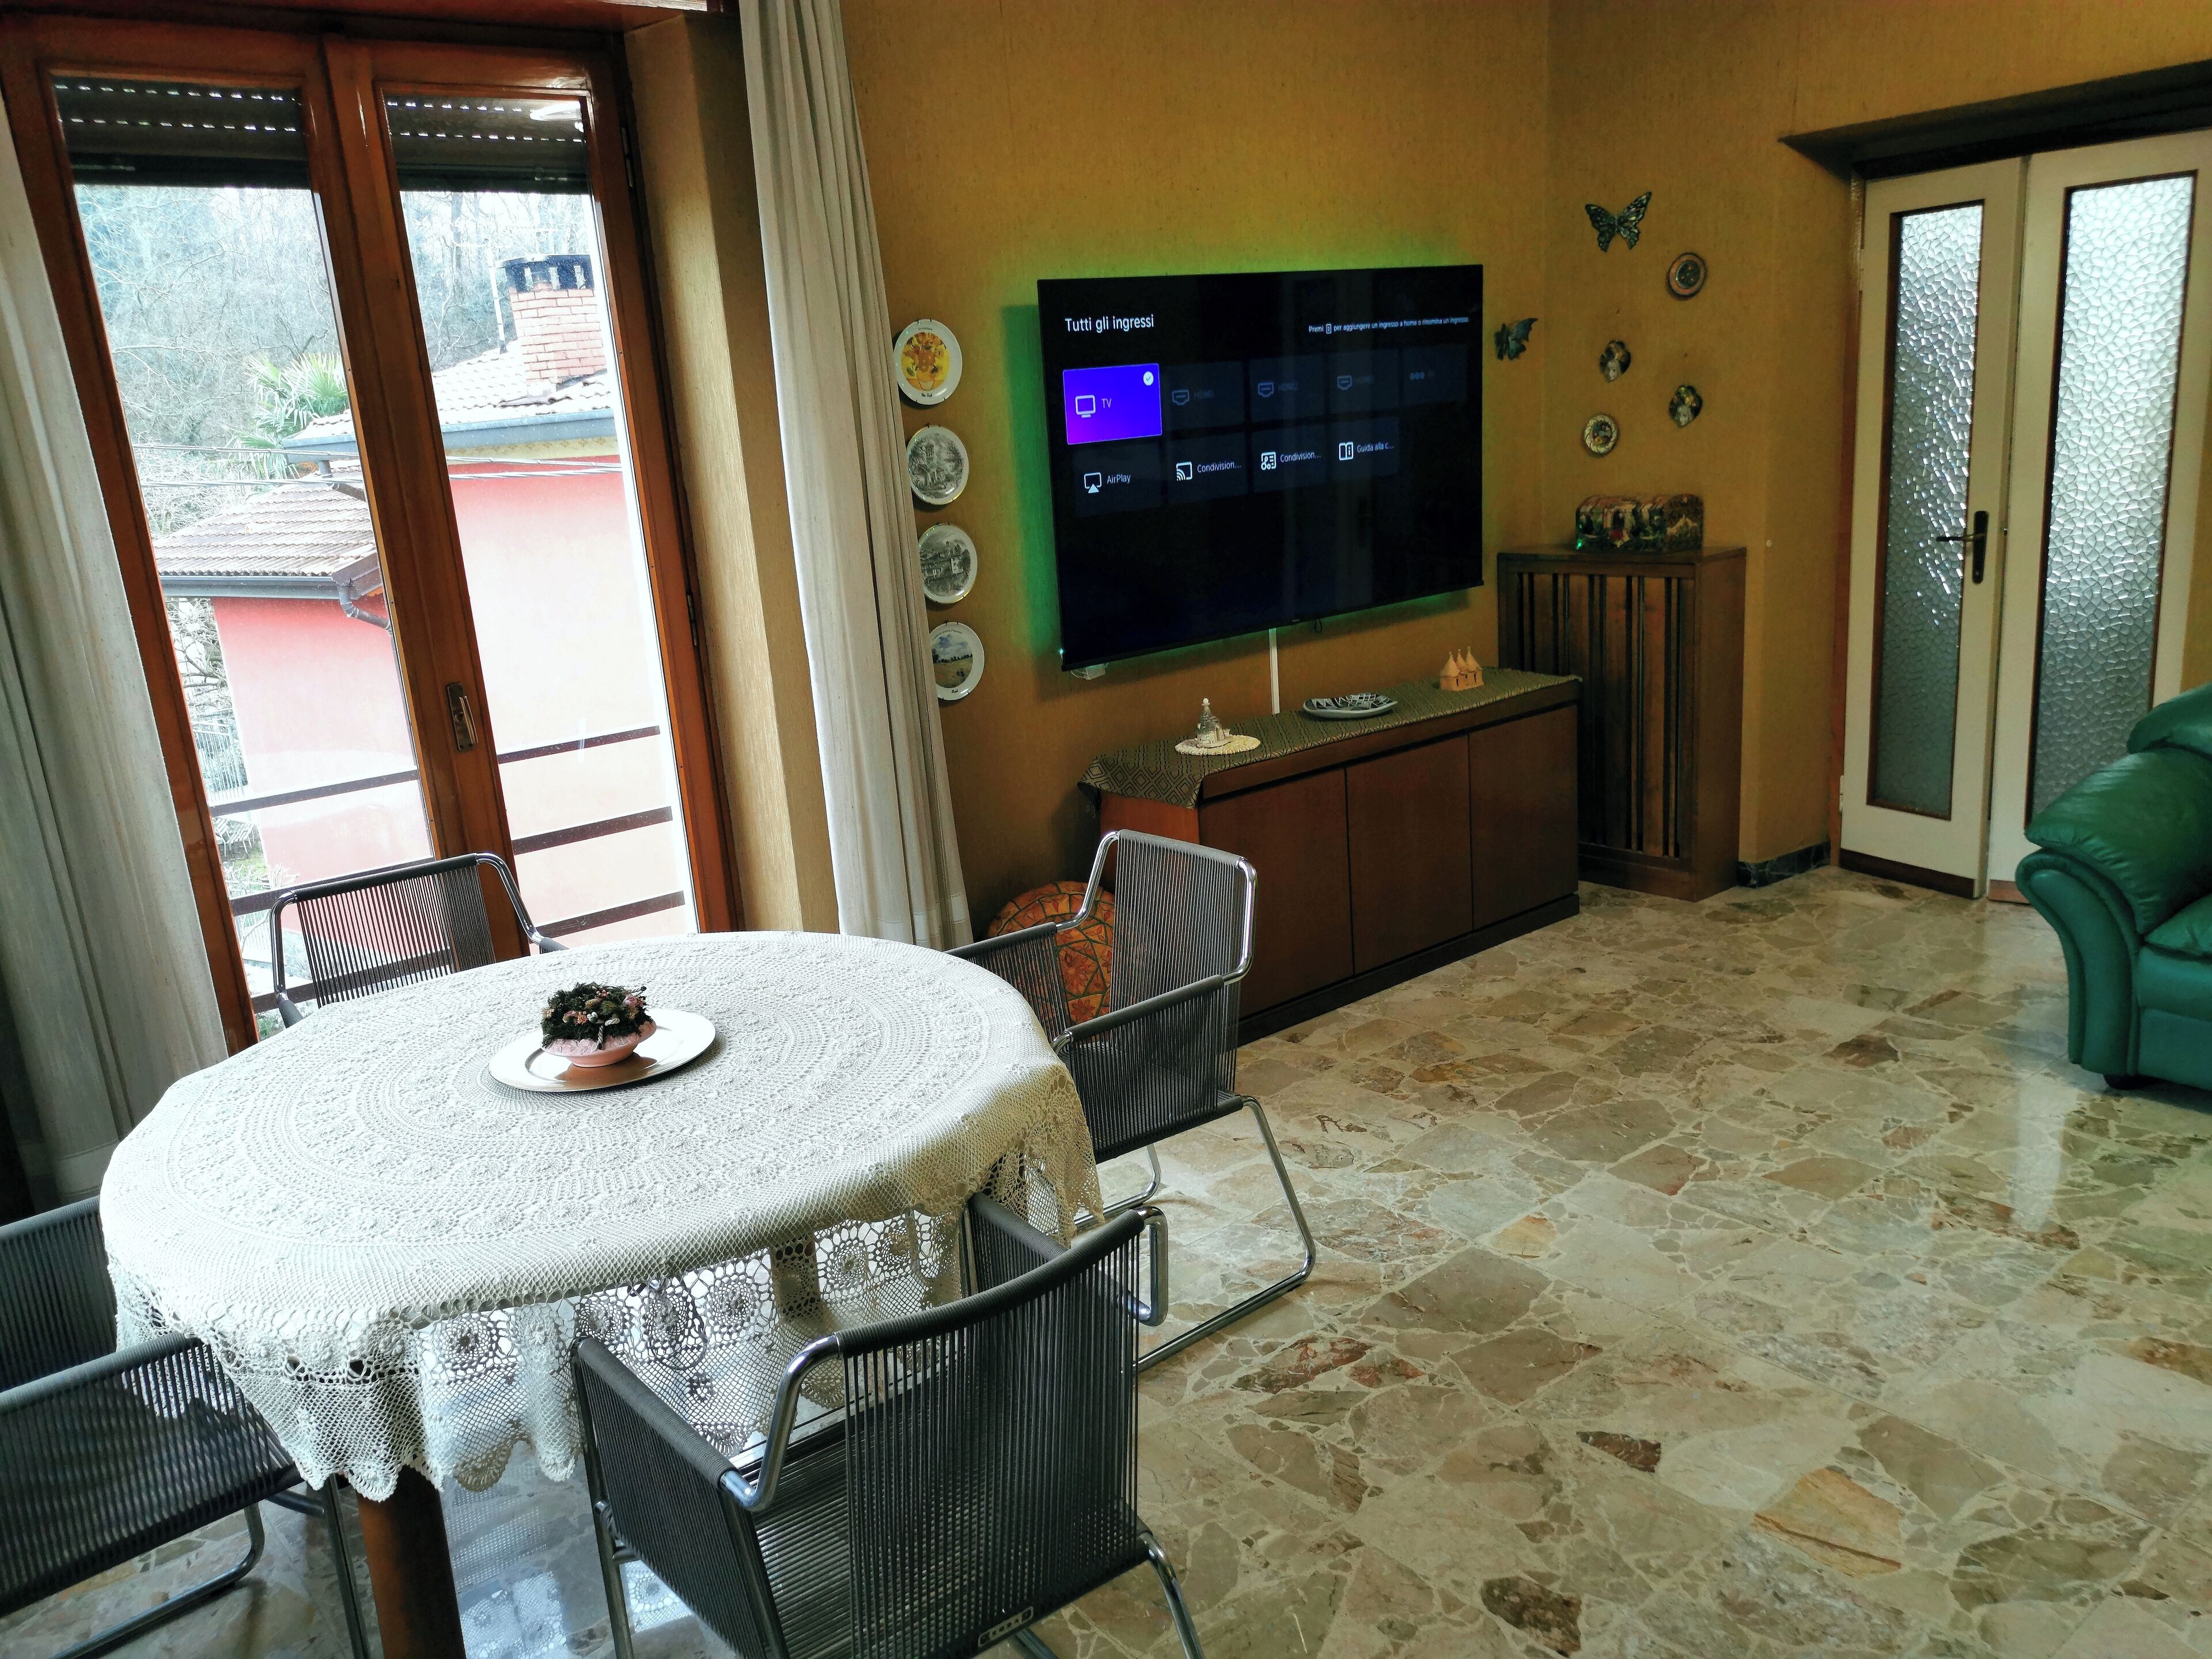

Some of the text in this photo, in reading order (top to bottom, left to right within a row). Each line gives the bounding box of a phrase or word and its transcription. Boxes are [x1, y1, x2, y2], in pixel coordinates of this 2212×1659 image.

[1065, 314, 1154, 334] Tutti gli ingressi
[1309, 325, 1324, 333] Premi
[1101, 397, 1112, 408] TV
[1357, 442, 1373, 453] Guida
[1197, 460, 1241, 474] Condivision...
[1107, 474, 1131, 484] AirPlay
